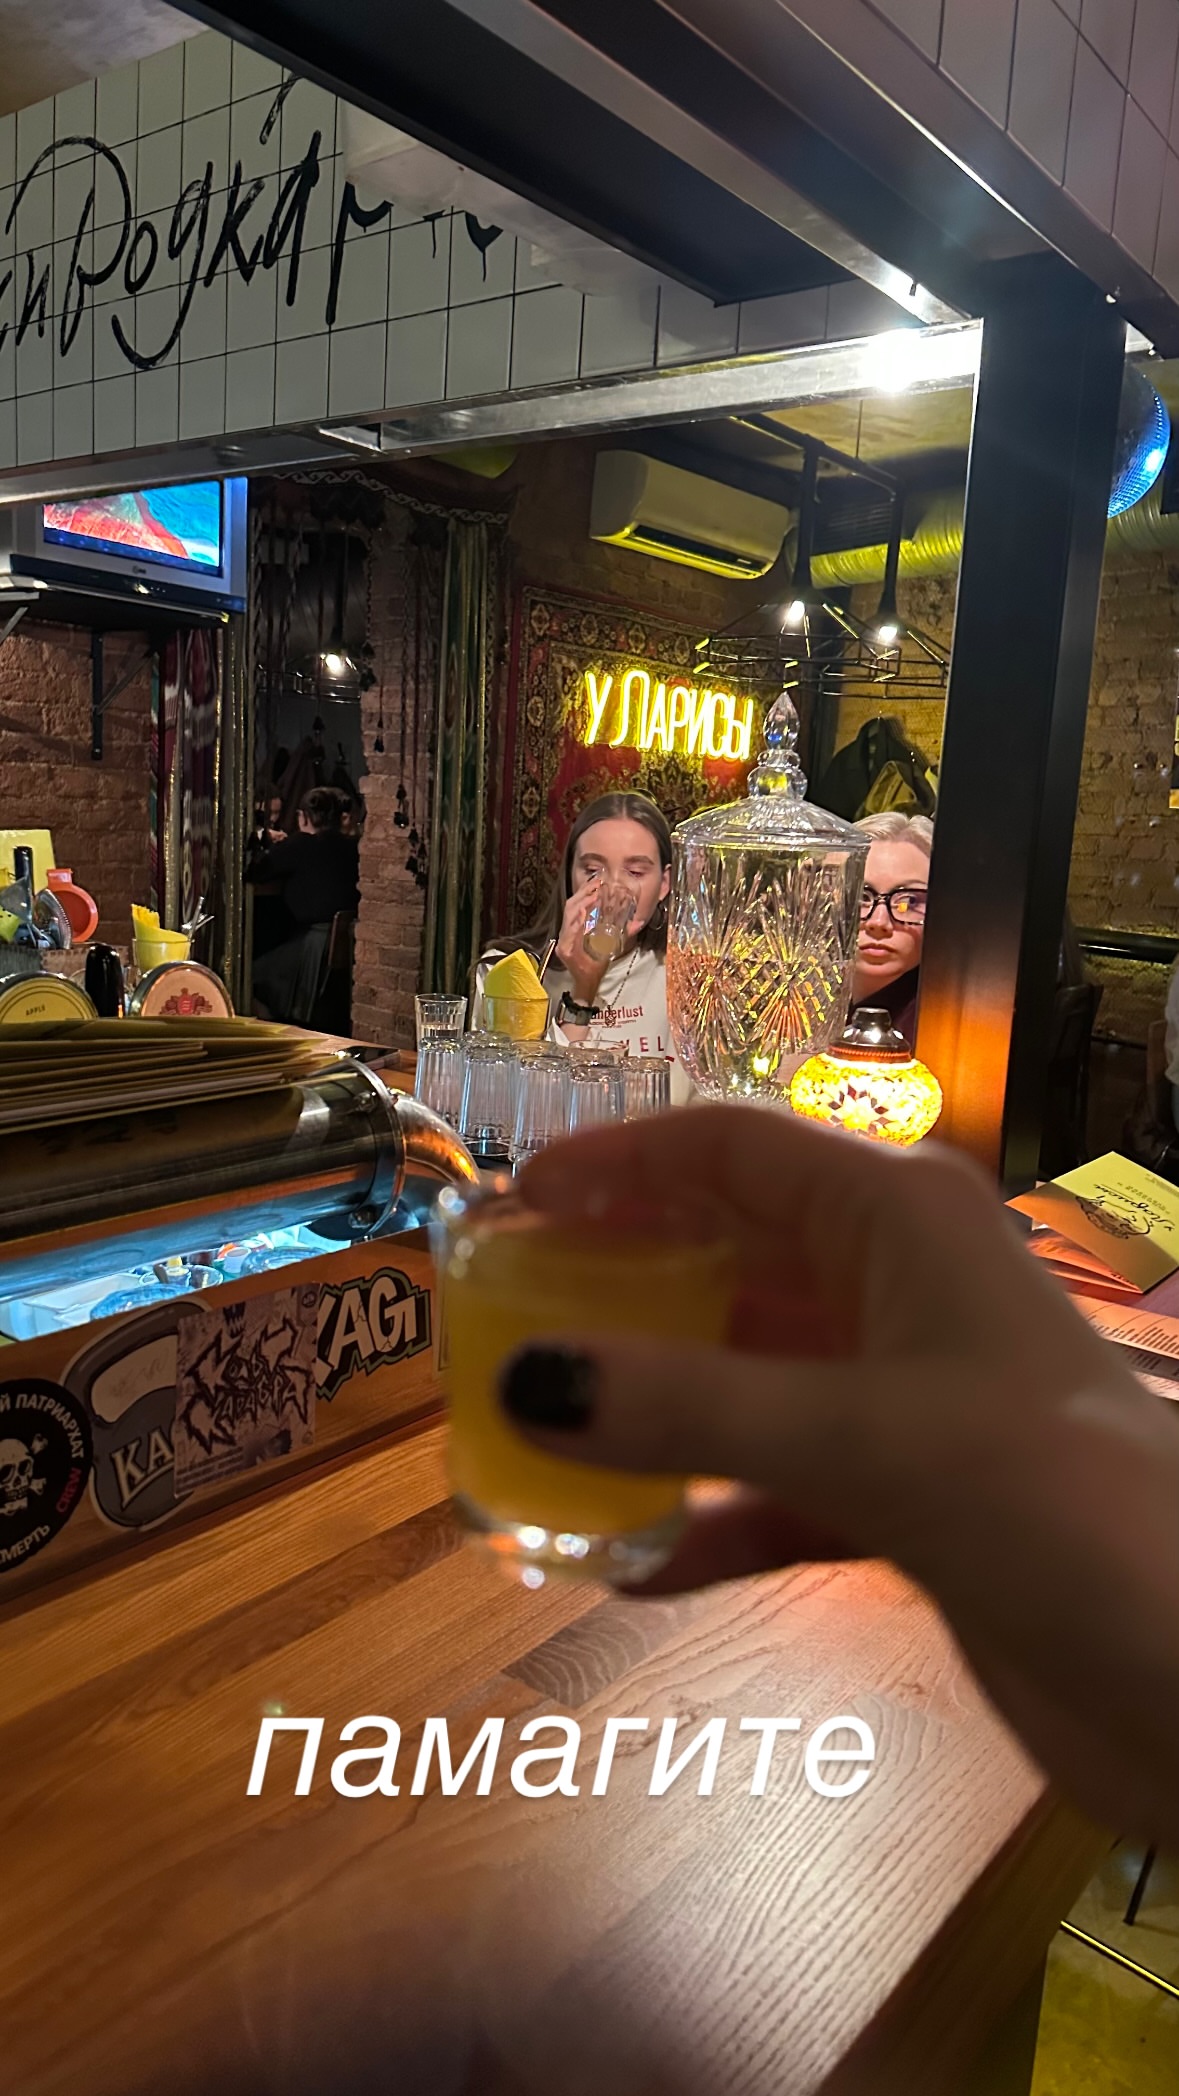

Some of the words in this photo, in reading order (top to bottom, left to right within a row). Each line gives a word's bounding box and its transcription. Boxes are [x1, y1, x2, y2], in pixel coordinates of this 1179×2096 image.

[584, 670, 613, 748] У
[26, 1004, 45, 1016] APPLE
[15, 1394, 84, 1459] ПАТРИАРХАТ
[56, 1467, 82, 1513] CREW
[0, 1525, 51, 1563] МЕРТЬ
